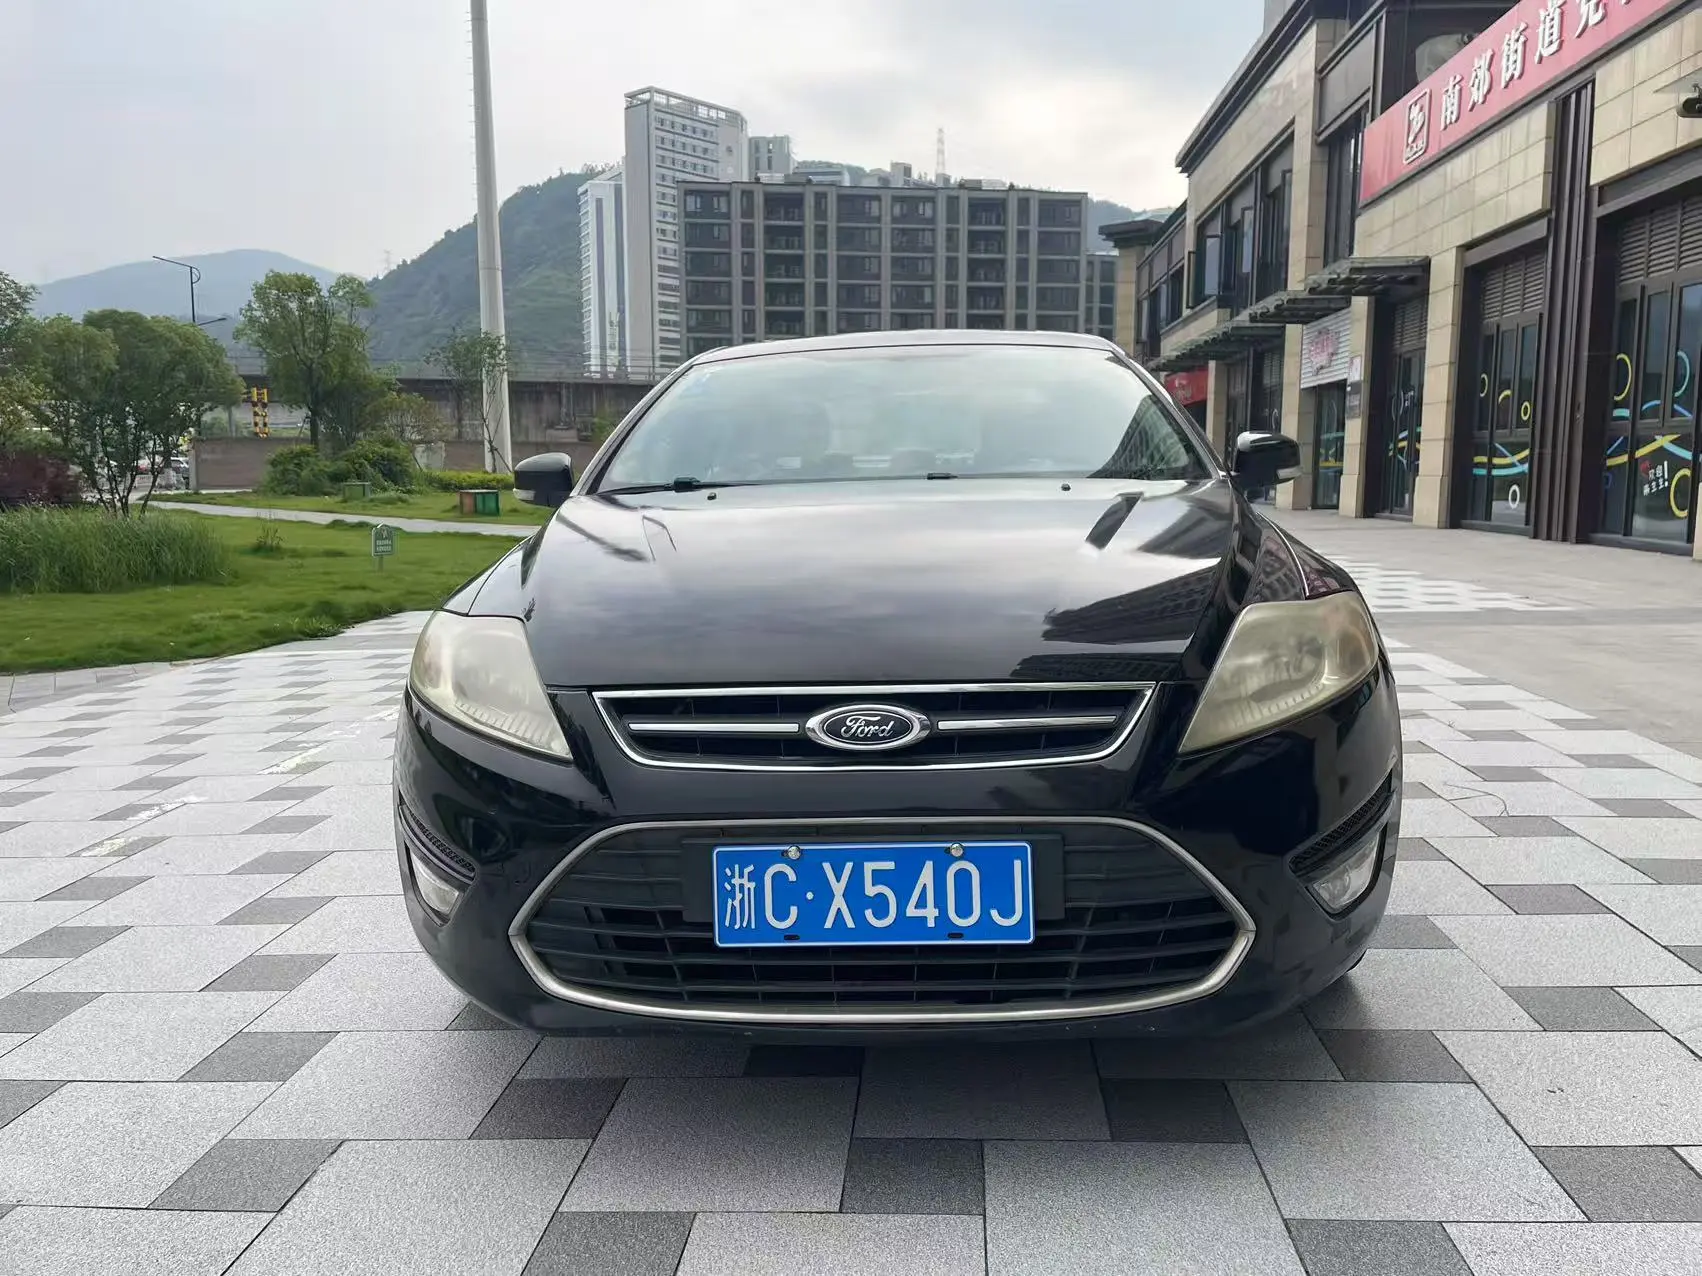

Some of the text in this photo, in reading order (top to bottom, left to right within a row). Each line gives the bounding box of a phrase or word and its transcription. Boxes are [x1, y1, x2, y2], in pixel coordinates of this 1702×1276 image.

[1440, 0, 1631, 131] 南郊街道
[841, 715, 894, 738] Ford
